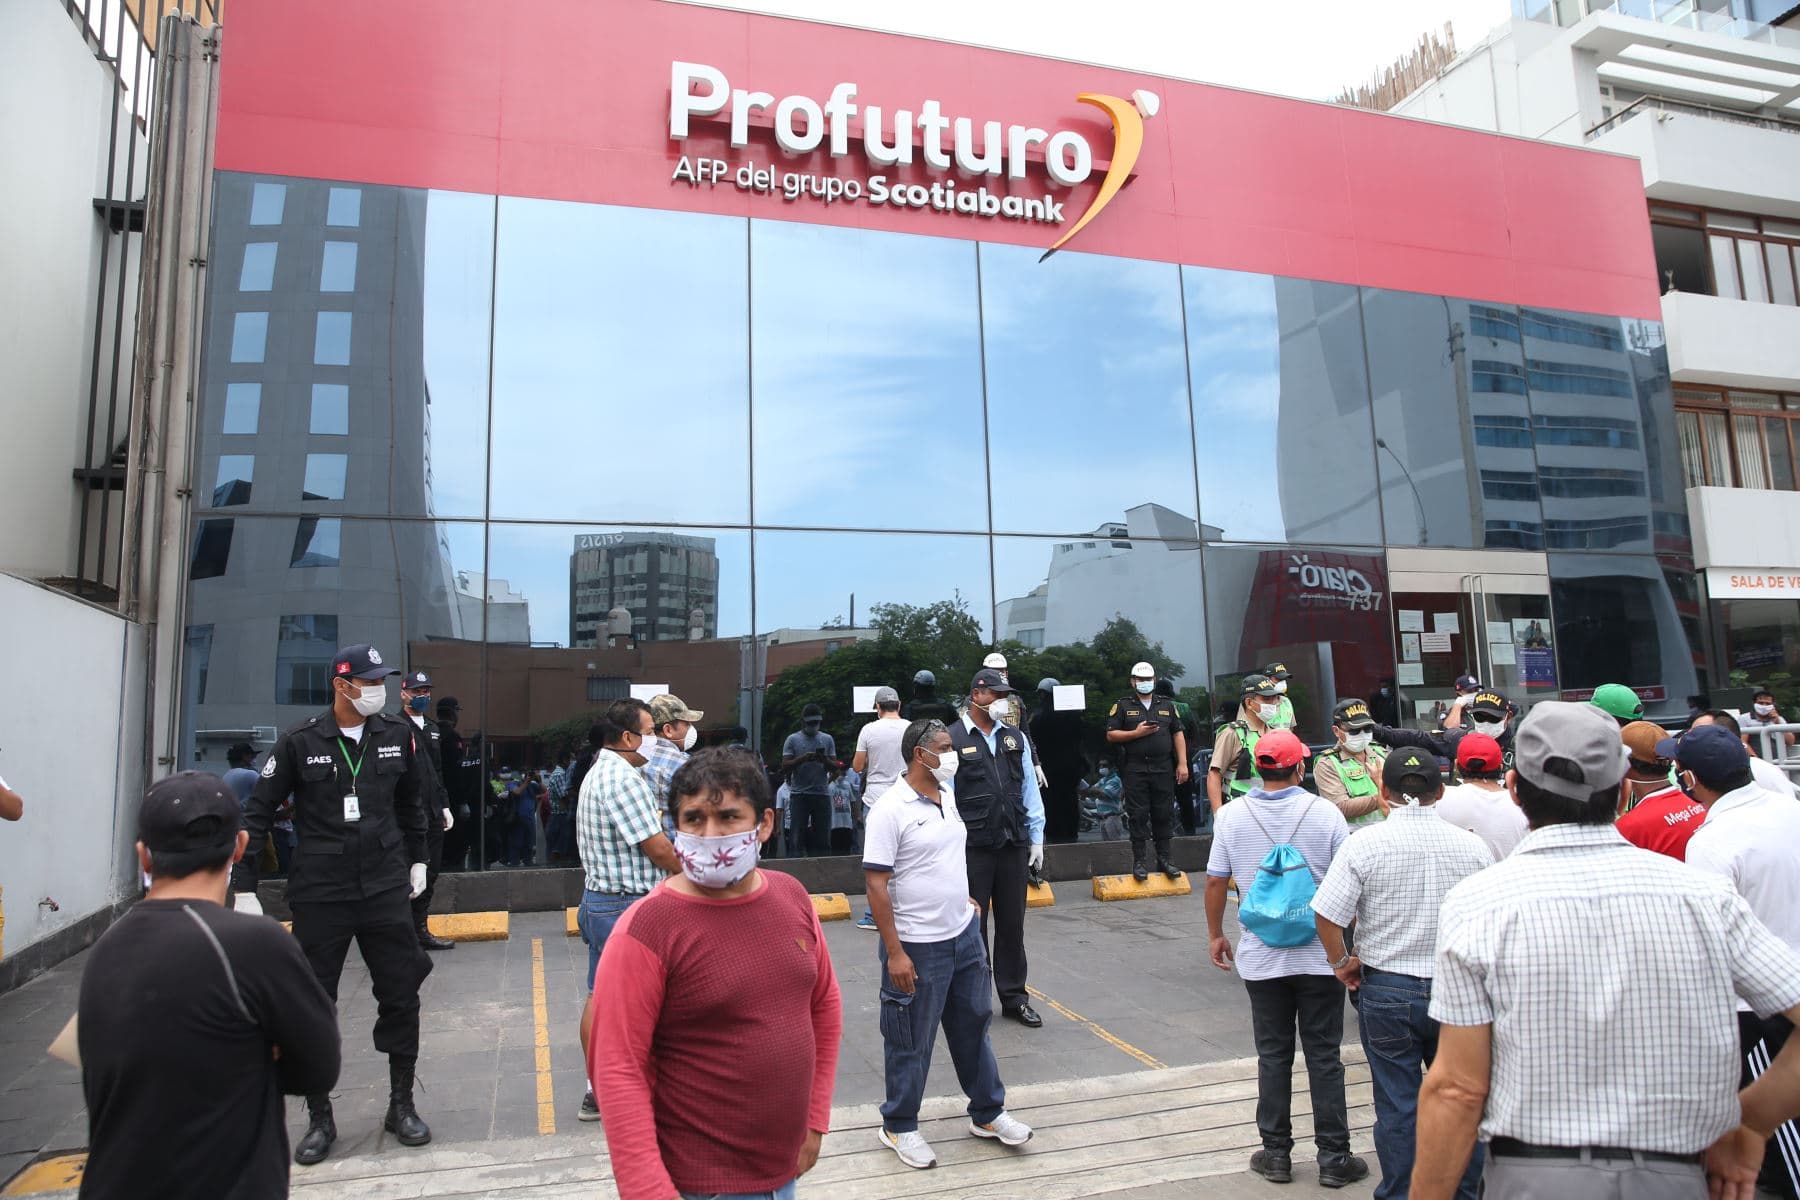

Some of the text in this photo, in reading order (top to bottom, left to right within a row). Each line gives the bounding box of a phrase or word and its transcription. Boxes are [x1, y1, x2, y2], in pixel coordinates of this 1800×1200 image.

[670, 60, 1092, 186] Profuturo
[671, 155, 1066, 223] AFP del grupo Scotiabank
[1730, 575, 1765, 588] SALA
[1768, 575, 1785, 588] DE
[1475, 693, 1503, 707] POLICIA
[306, 755, 333, 765] GAES
[1663, 809, 1692, 826] Mega
